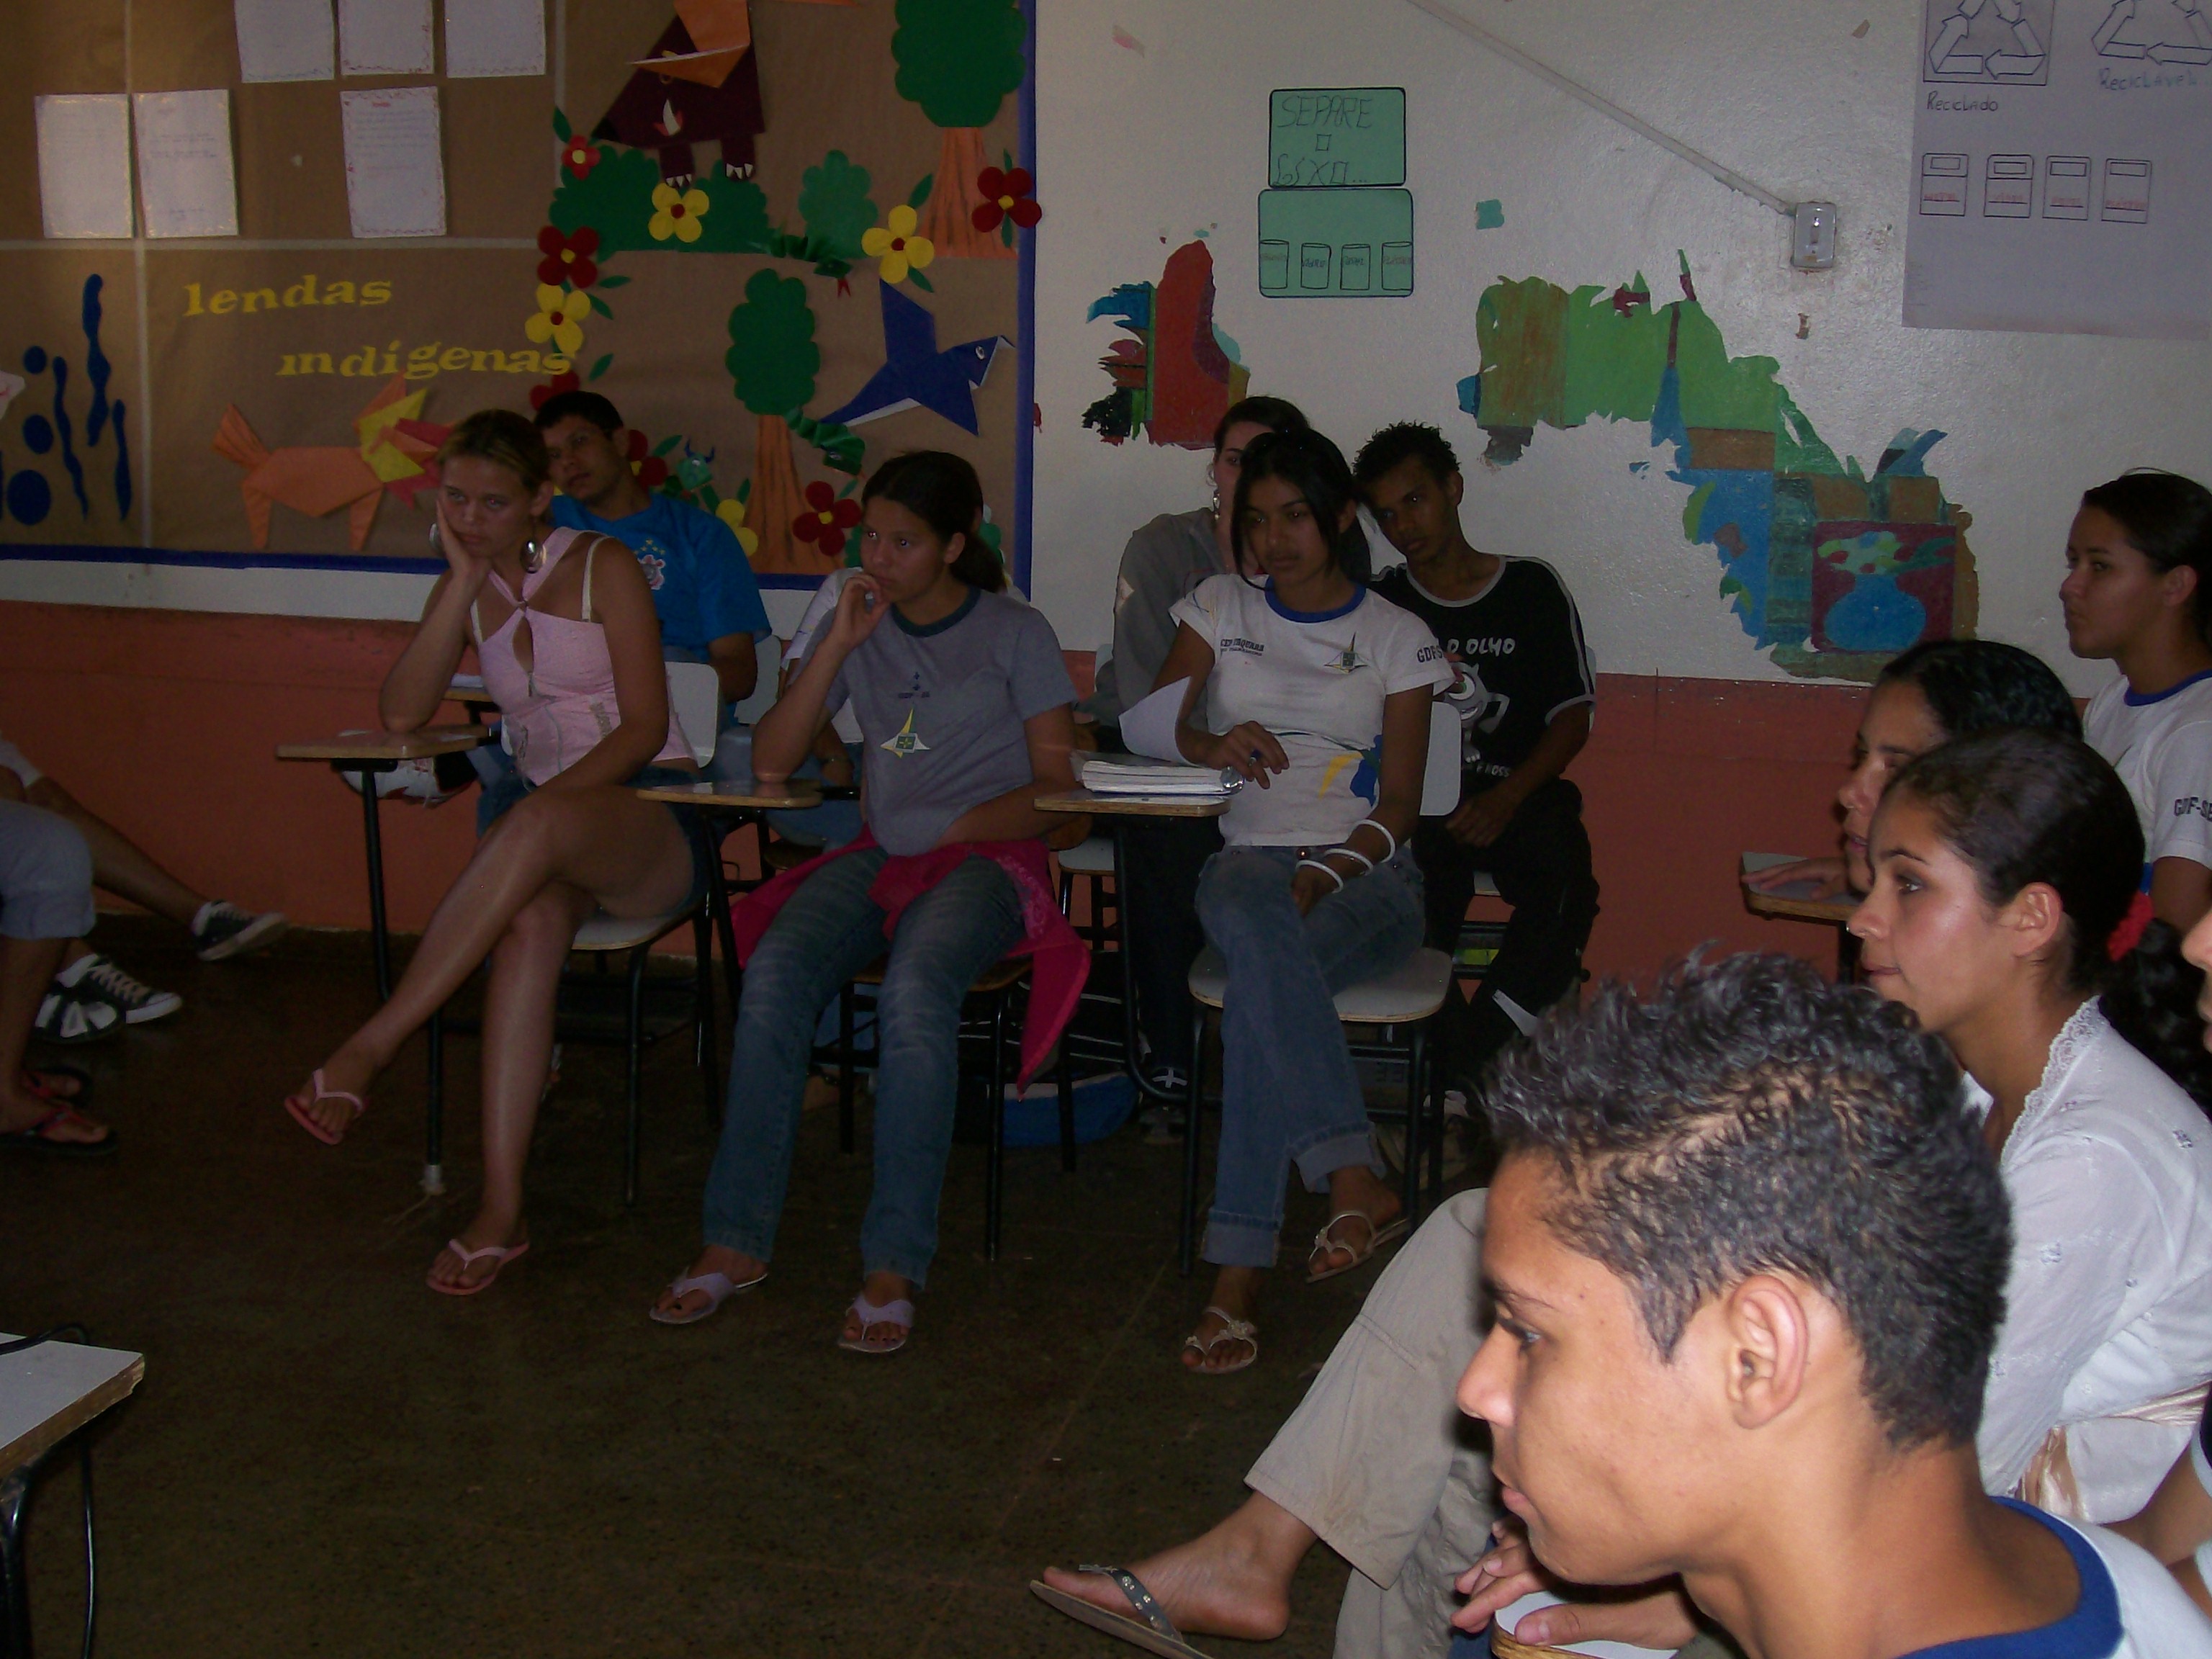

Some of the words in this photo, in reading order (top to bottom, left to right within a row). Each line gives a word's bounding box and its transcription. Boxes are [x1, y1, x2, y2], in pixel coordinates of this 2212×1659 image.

[1277, 94, 1372, 128] SEPARE
[182, 274, 392, 317] lendas
[1465, 637, 1517, 657] OLHO
